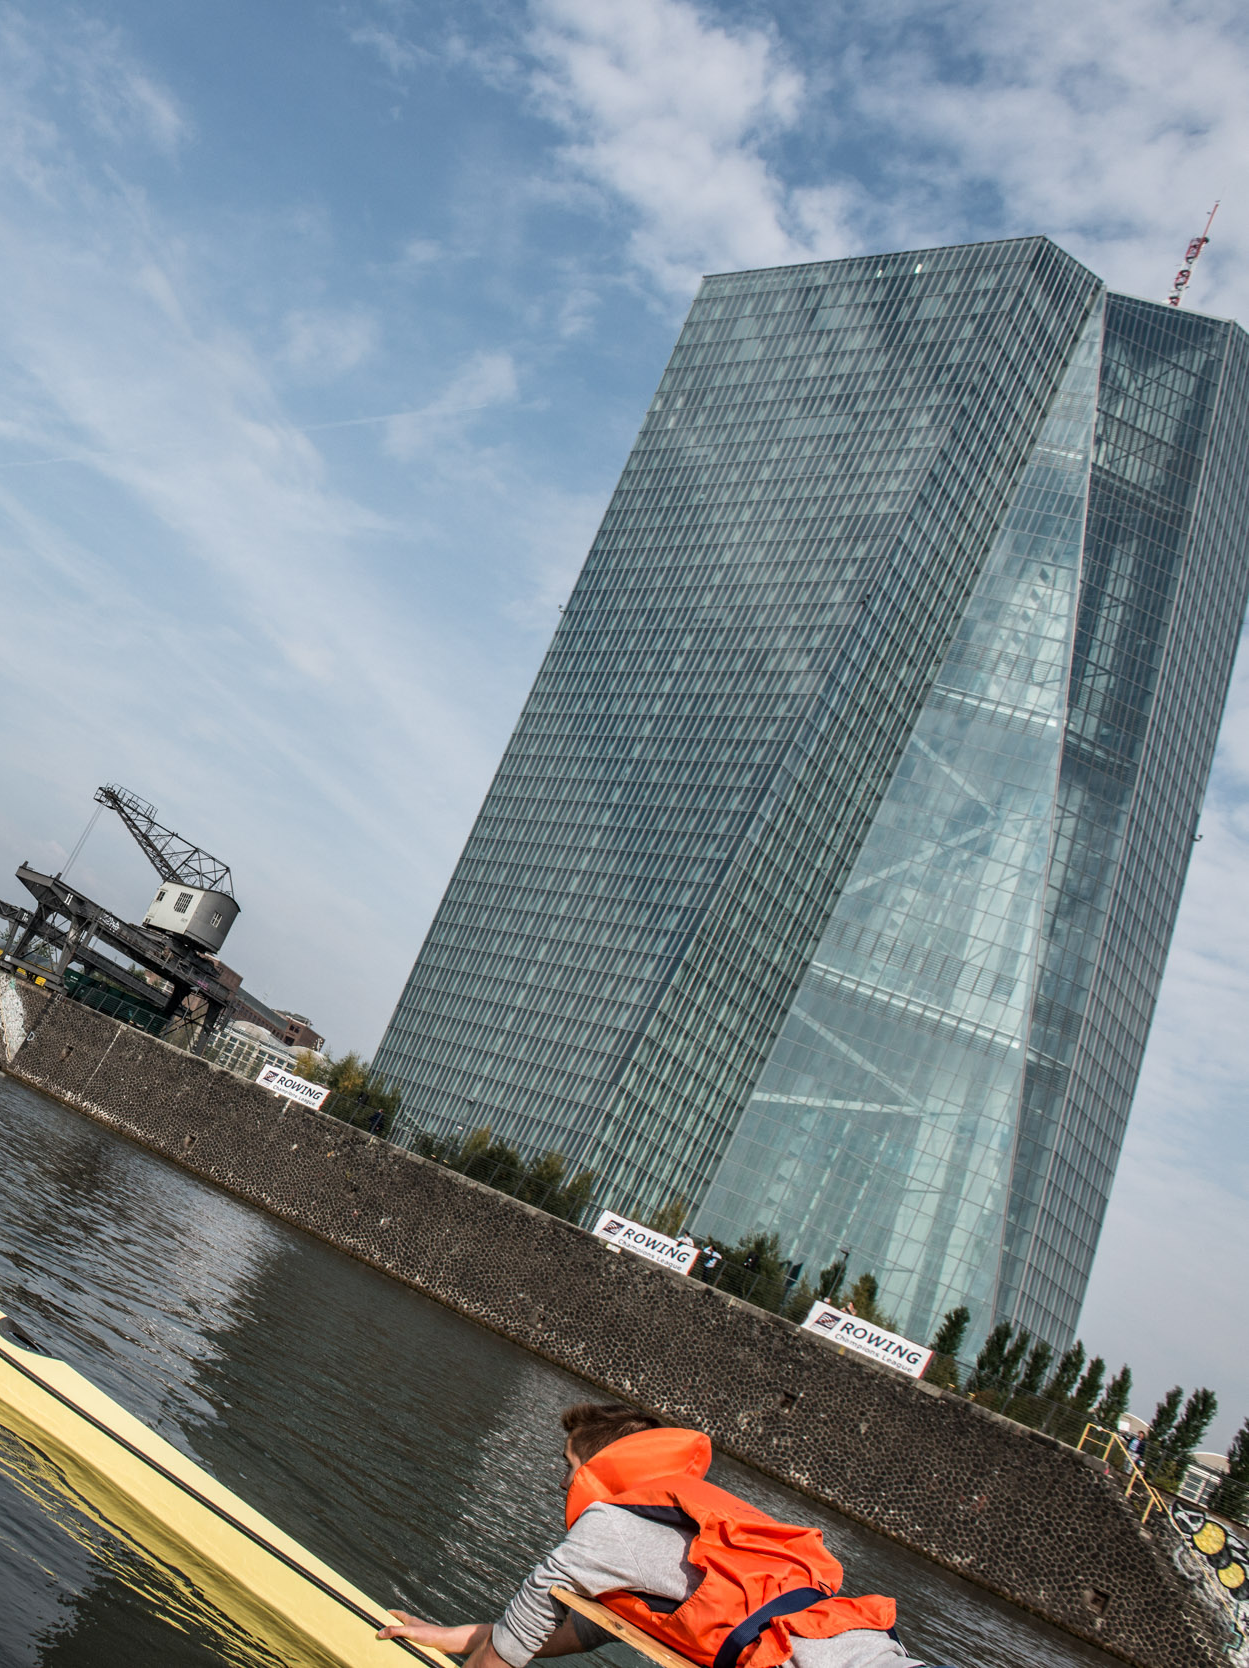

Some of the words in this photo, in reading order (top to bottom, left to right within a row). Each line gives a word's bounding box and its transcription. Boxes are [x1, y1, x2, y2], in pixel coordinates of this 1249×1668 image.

[277, 1076, 323, 1100] ROWING
[618, 1239, 655, 1259] Champions
[656, 1257, 682, 1271] League
[622, 1228, 690, 1263] ROWING
[835, 1333, 880, 1358] Champions
[882, 1354, 913, 1373] League
[840, 1322, 922, 1365] ROWING
